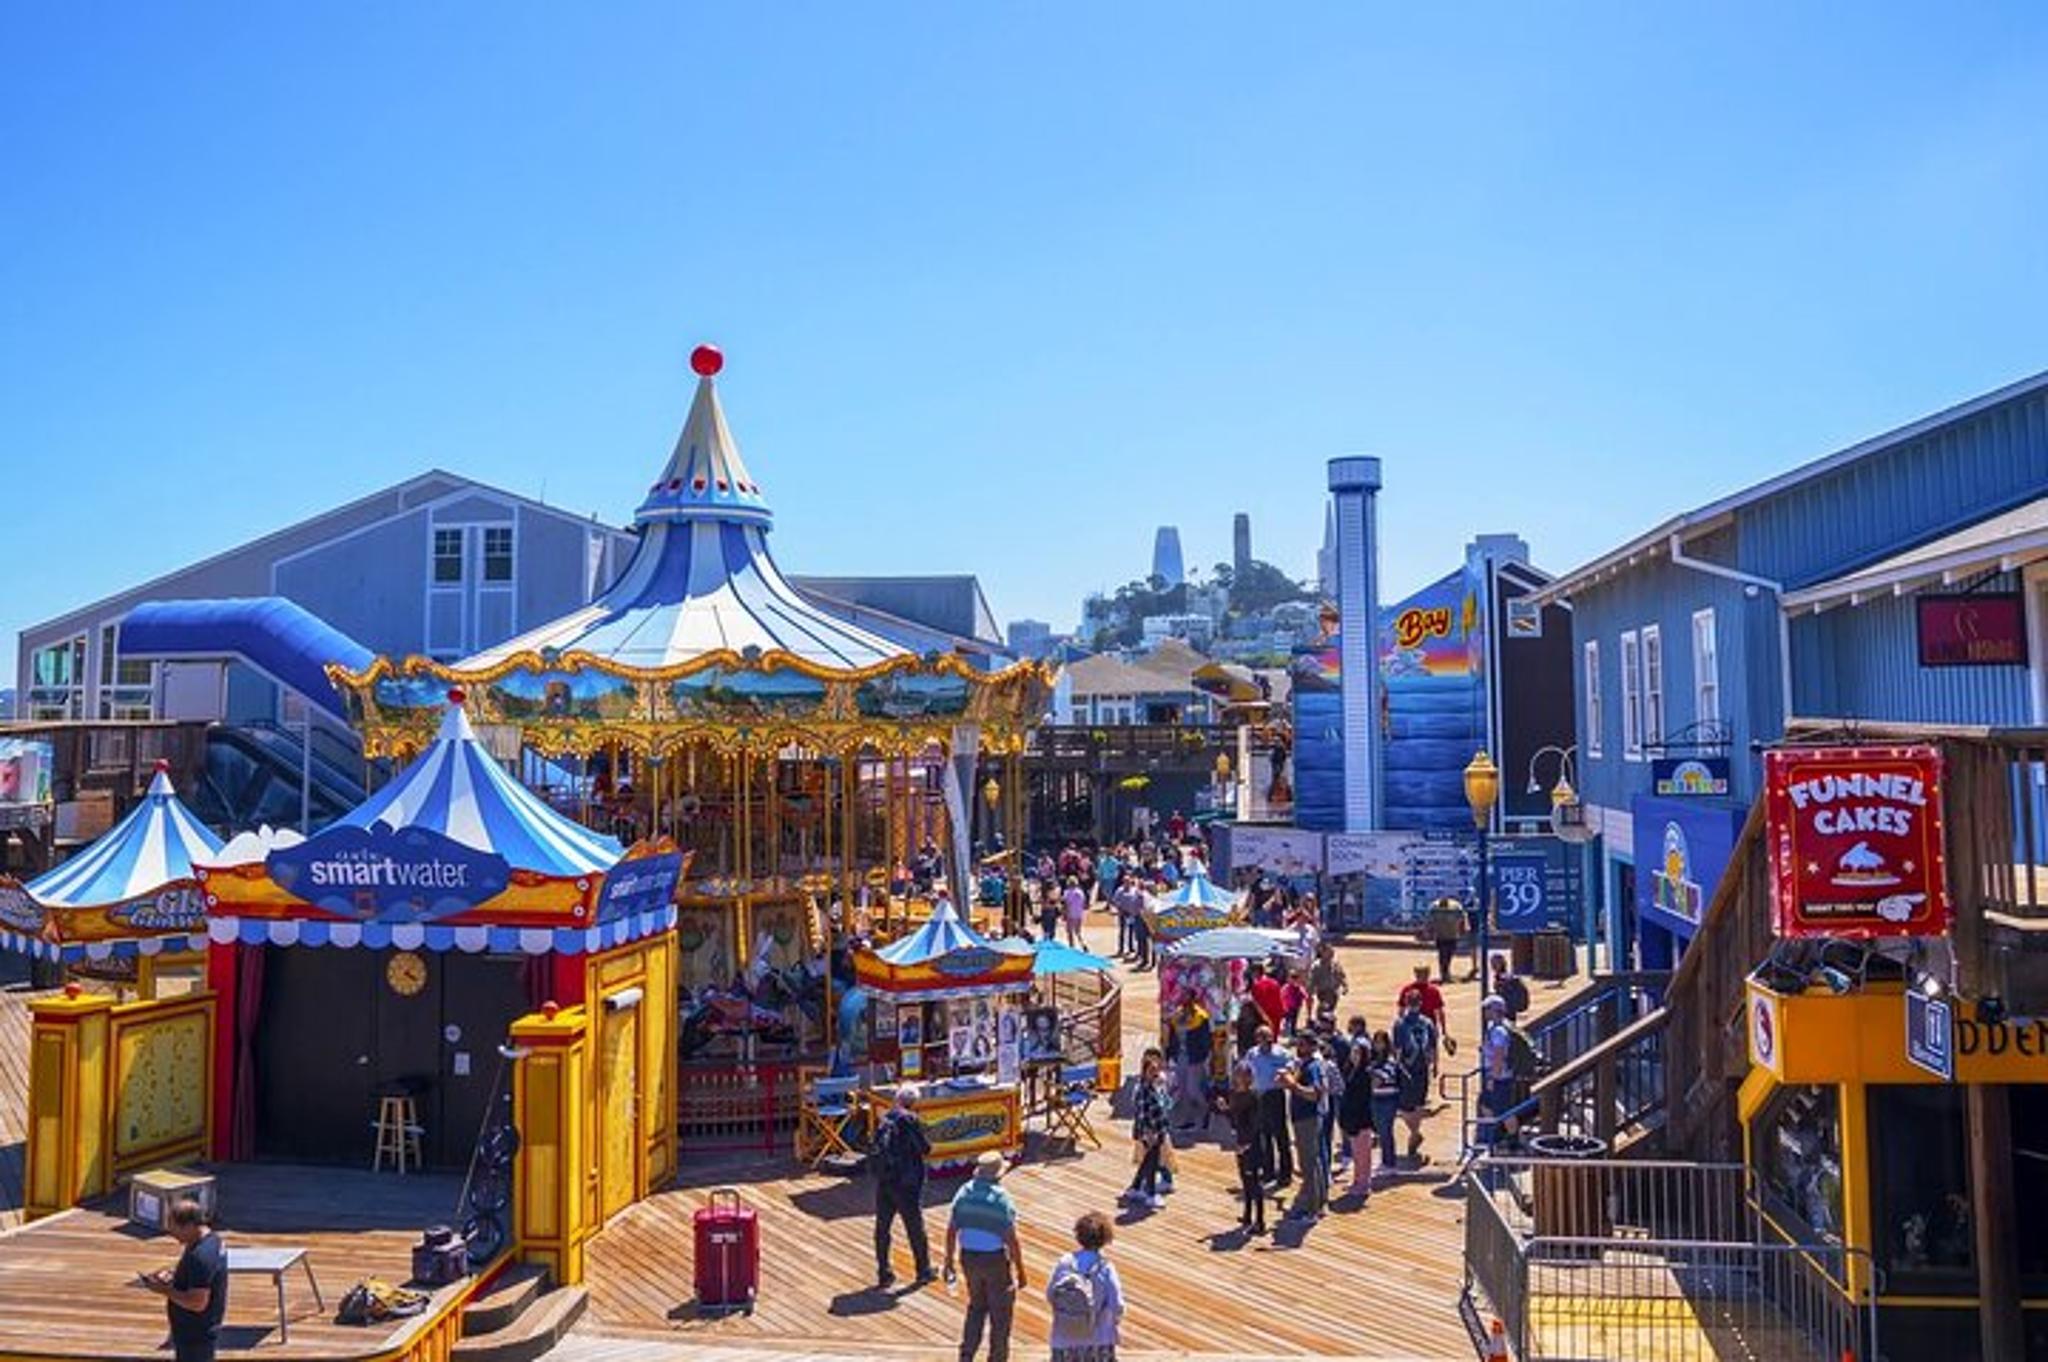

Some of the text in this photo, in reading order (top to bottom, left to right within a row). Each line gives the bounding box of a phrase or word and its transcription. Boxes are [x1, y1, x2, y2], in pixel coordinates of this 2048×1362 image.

[1398, 607, 1450, 647] Bay
[1788, 773, 1927, 809] FUNNEL
[1813, 806, 1912, 836] CAKES
[1331, 837, 1377, 848] COMING
[1331, 850, 1363, 861] SOON
[310, 857, 468, 887] smartwater
[1500, 866, 1540, 881] PIER
[1499, 883, 1541, 916] 39
